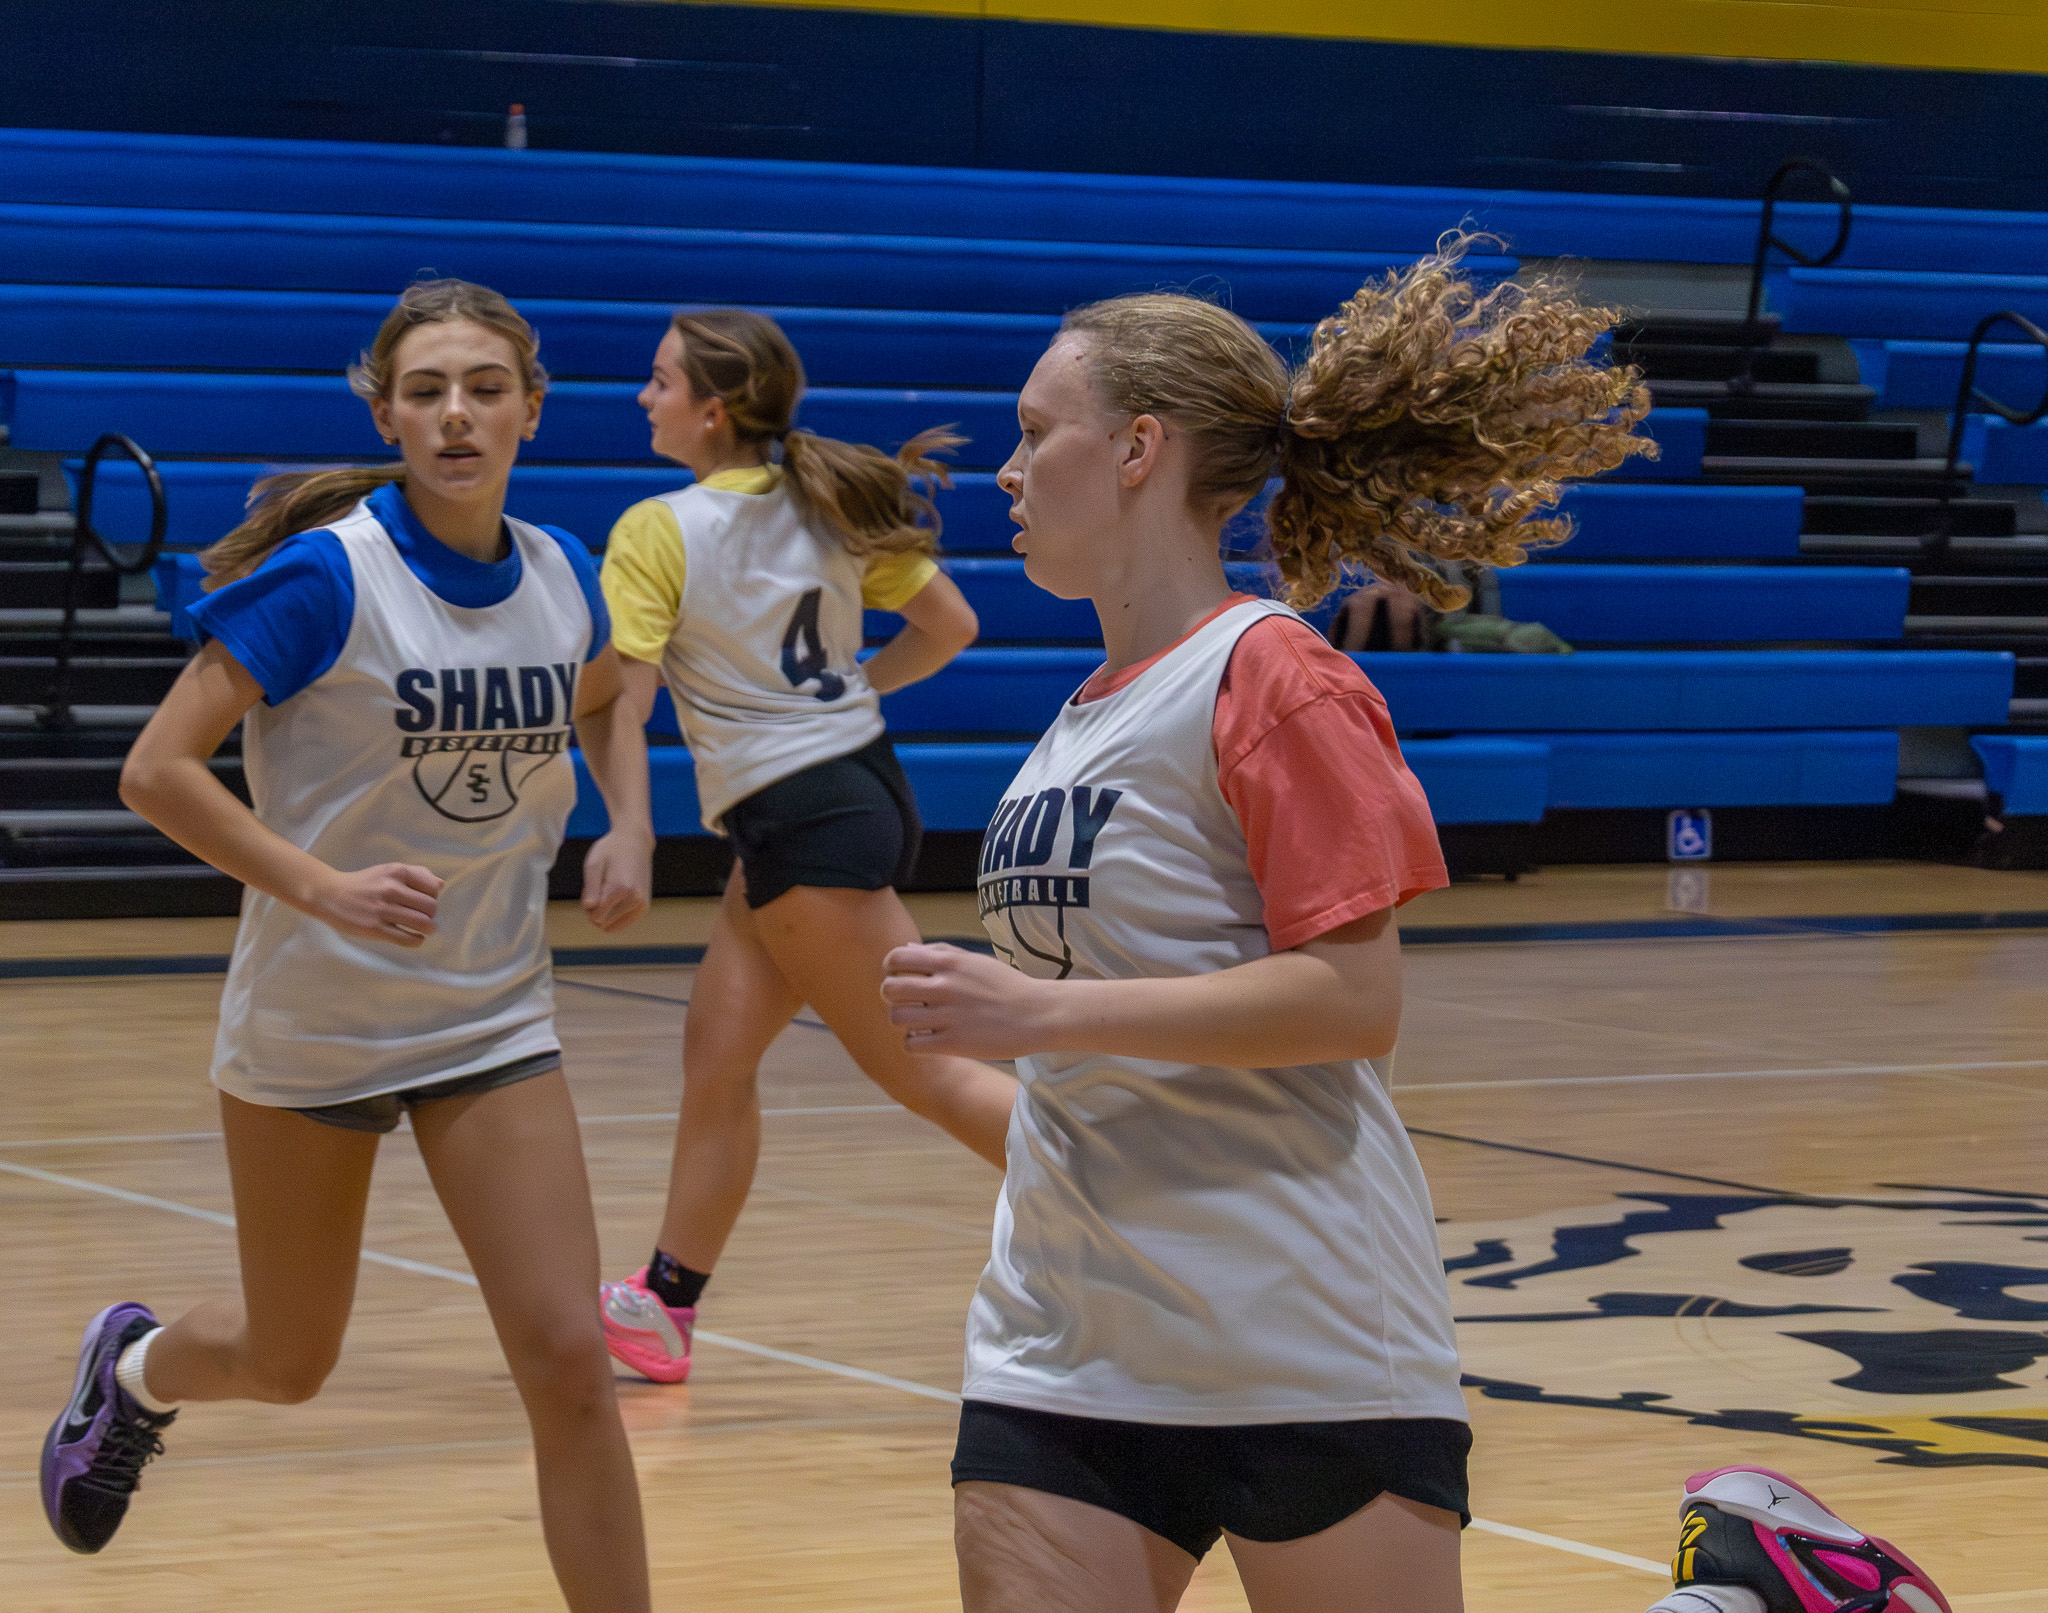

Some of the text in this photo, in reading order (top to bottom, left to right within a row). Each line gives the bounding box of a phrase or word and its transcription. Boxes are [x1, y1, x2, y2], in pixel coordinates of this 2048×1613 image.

[395, 662, 576, 732] SHADY
[978, 785, 1124, 877] HADY
[977, 878, 1081, 915] ASKETBALL
